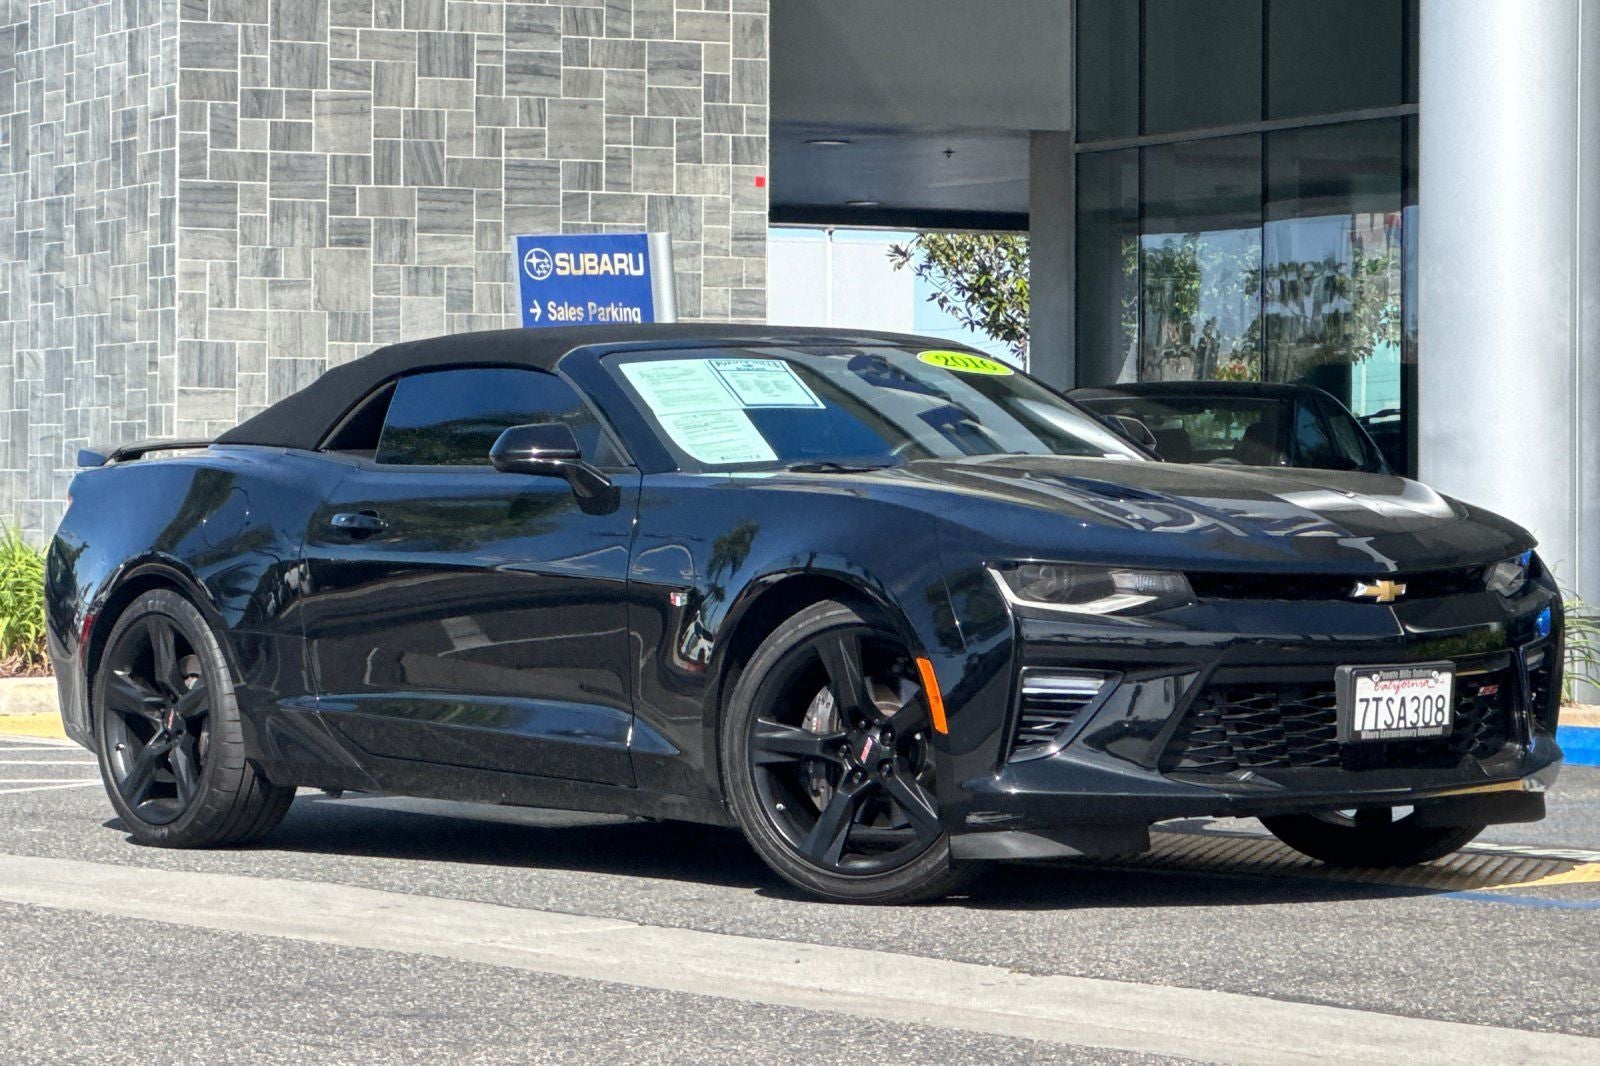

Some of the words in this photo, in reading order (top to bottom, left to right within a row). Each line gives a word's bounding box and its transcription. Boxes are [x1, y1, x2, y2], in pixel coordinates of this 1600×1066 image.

[554, 252, 644, 276] SUBARU
[547, 301, 585, 322] Sales
[588, 301, 642, 324] Parking
[935, 355, 998, 371] 2016
[1374, 678, 1435, 695] California
[1358, 694, 1446, 730] 7TSA308
